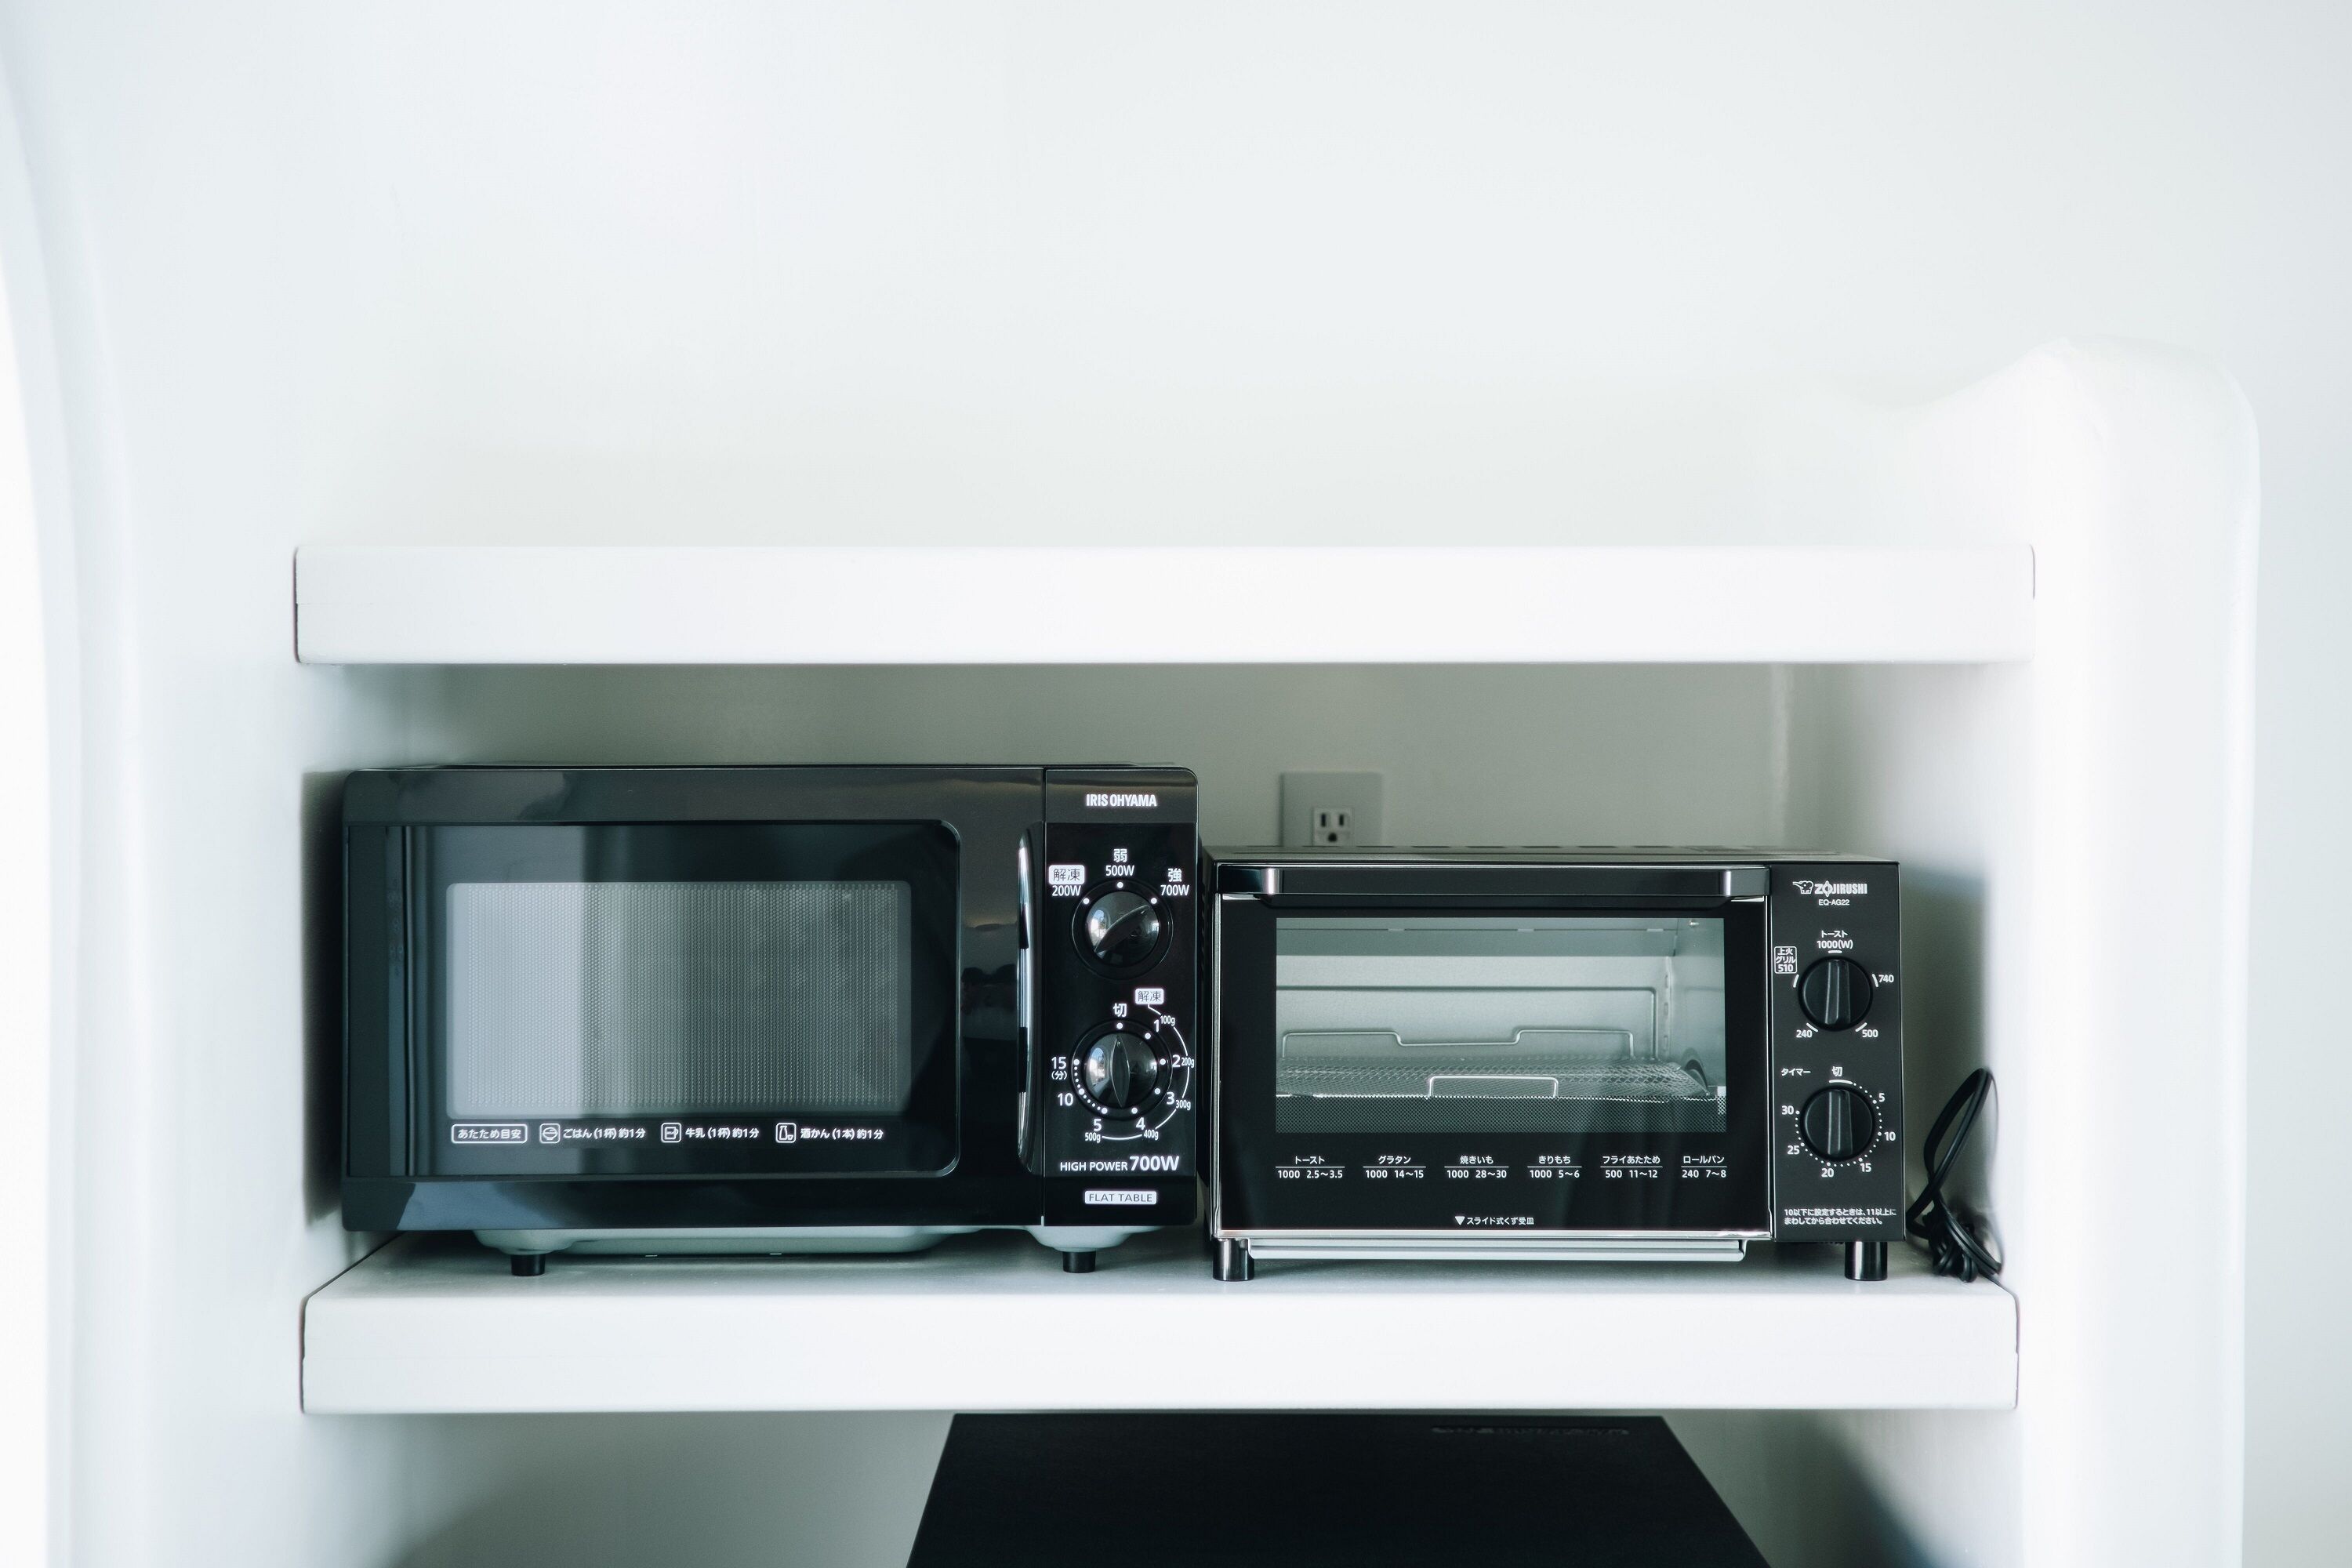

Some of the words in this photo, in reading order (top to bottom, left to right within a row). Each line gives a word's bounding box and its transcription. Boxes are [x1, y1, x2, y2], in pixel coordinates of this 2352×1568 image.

[1086, 794, 1108, 807] IRIS
[1110, 794, 1157, 807] OHYAMA
[1114, 848, 1127, 862] 弱
[1054, 869, 1080, 881] 解凍
[1105, 865, 1134, 876] 500W
[1168, 868, 1182, 882] 強
[1052, 886, 1081, 897] 200W
[1160, 884, 1189, 896] 700W
[1814, 880, 1867, 897] ZOJIRUSHI
[1817, 939, 1853, 949] 1000(W)
[1775, 956, 1795, 964] グリル
[1138, 991, 1160, 1002] 解凍
[1113, 1004, 1127, 1017] 切
[1160, 1016, 1175, 1026] 100g
[1154, 1020, 1160, 1033] 1
[1796, 1029, 1813, 1038] 240
[1862, 1029, 1878, 1038] 500
[1051, 1057, 1067, 1069] 15
[1172, 1054, 1181, 1067] 2
[1181, 1058, 1195, 1069] 200g
[1831, 1066, 1842, 1076] 切
[1058, 1093, 1073, 1106] 10
[1167, 1091, 1174, 1105] 3
[1879, 1093, 1885, 1102] 5
[1176, 1100, 1191, 1110] 300g
[1782, 1105, 1794, 1115] 30
[1094, 1119, 1102, 1131] 5
[1136, 1117, 1145, 1130] 4
[458, 1129, 521, 1139] あたため目安
[1085, 1133, 1101, 1143] 500g
[1144, 1130, 1159, 1140] 400g
[1884, 1131, 1896, 1141] 10
[1788, 1145, 1799, 1154] 25
[1060, 1162, 1086, 1171] HIGH
[1090, 1162, 1127, 1171] POWER
[1130, 1156, 1179, 1171] 700W
[1296, 1156, 1324, 1164] トースト
[1378, 1156, 1410, 1164] グラタン
[1461, 1156, 1494, 1164] 焼きいも
[1539, 1156, 1570, 1164] きりもち
[1821, 1168, 1834, 1178] 20
[1860, 1163, 1871, 1173] 15
[1089, 1193, 1115, 1202] FLAT
[1119, 1193, 1153, 1202] TABLE
